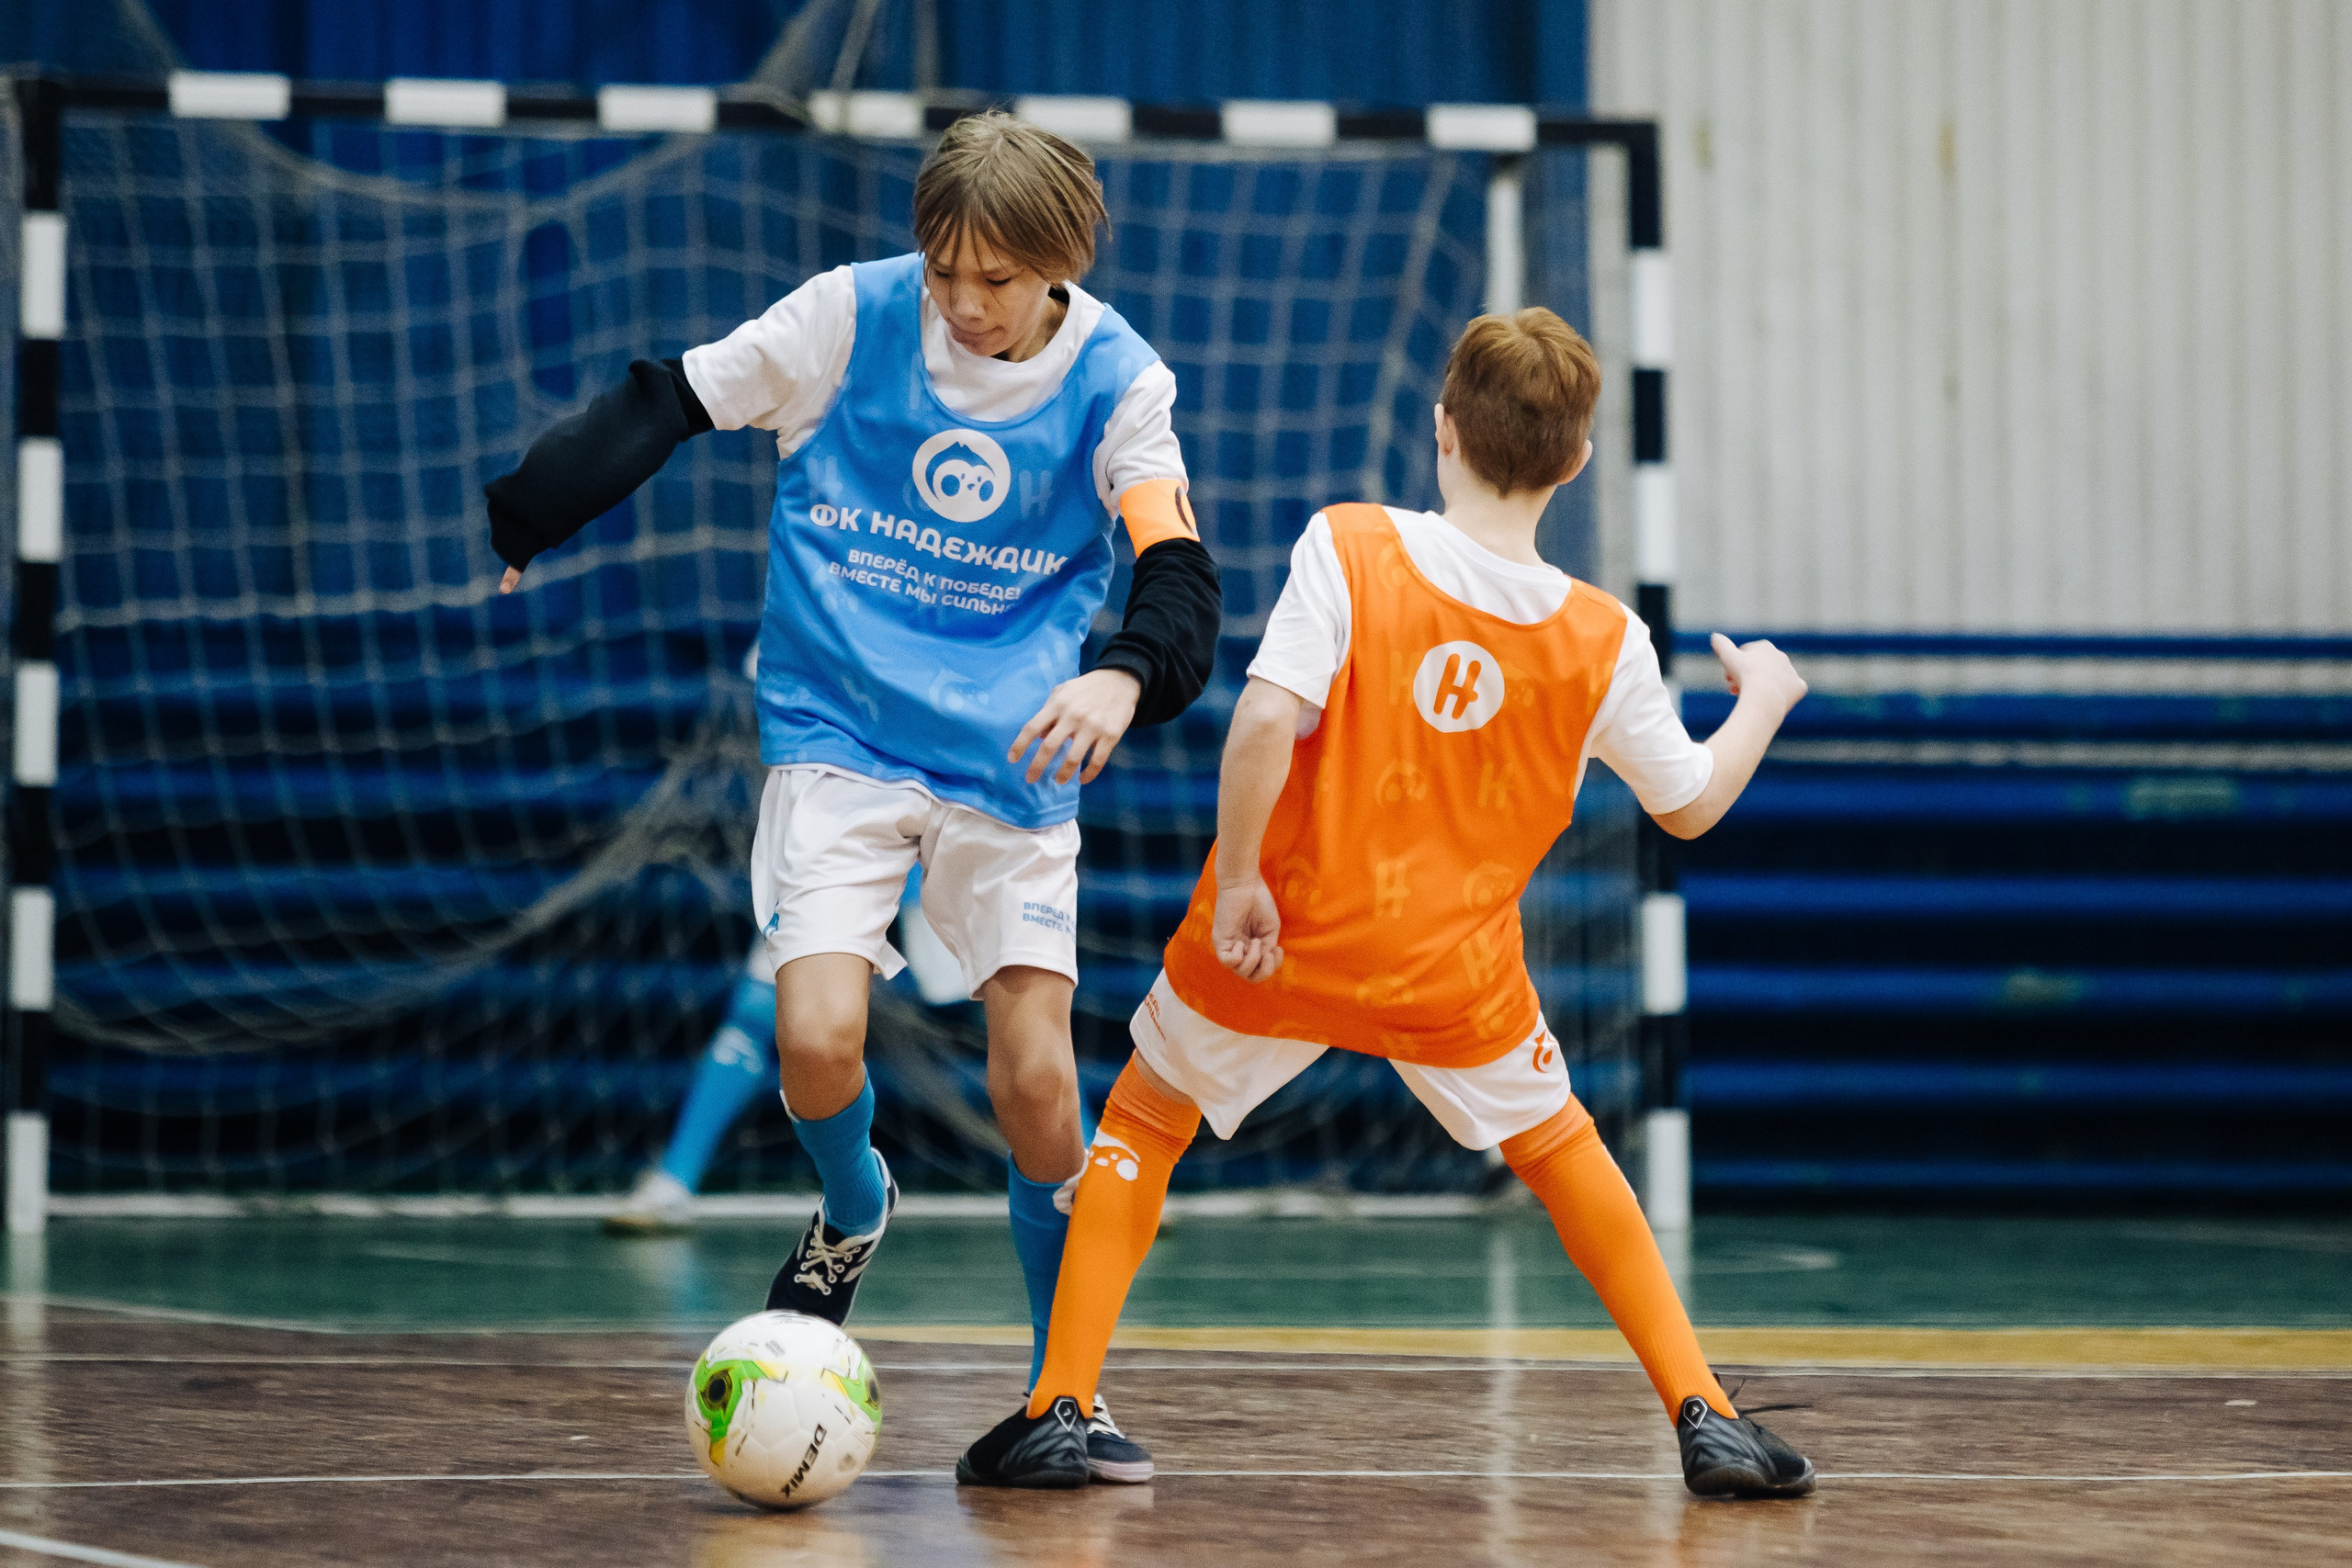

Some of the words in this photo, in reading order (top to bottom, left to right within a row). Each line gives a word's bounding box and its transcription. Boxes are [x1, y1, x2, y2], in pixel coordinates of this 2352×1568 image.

[809, 503, 863, 532] ФК
[869, 511, 1069, 576] НАДЕЖДИК
[829, 560, 902, 593] ВМЕСТЕ
[905, 582, 937, 605] МЫ
[847, 548, 920, 583] ВПЕРЁД
[923, 571, 937, 587] К
[939, 576, 1022, 602] ПОБЕДЕ!
[1022, 913, 1064, 933] ВМЕСТЕ
[780, 1423, 827, 1499] DEMIX
